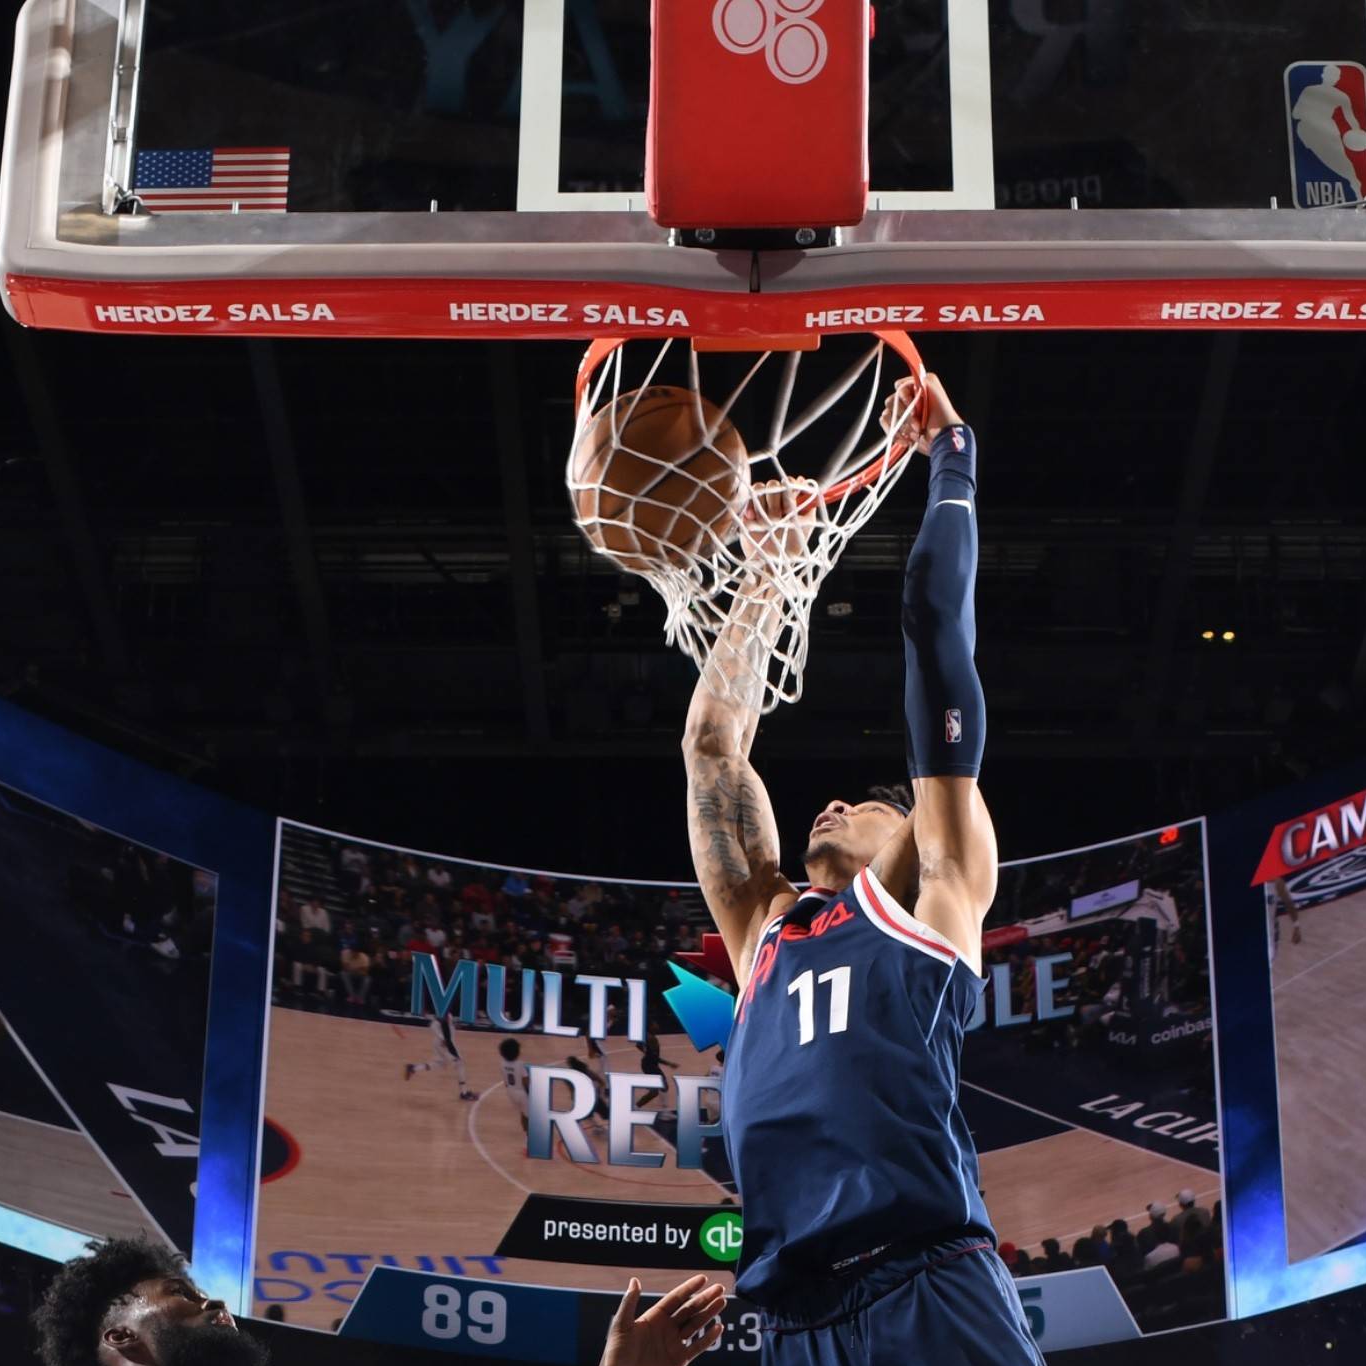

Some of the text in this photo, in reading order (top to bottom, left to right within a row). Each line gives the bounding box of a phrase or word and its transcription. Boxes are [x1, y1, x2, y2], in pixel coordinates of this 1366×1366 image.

[1305, 180, 1347, 206] NBA
[95, 302, 335, 324] HERDEZ SALSA
[449, 302, 690, 327] HERDEZ SALSA
[805, 303, 1045, 328] HERDEZ SALSA
[1160, 301, 1282, 320] HERDEZ
[409, 952, 648, 1044] MULTI
[787, 965, 853, 1047] 11
[1151, 1018, 1214, 1044] coinbas
[525, 1064, 725, 1170] REP
[1080, 1094, 1145, 1121] LA
[544, 1218, 658, 1245] presented
[664, 1223, 692, 1250] by
[421, 1283, 508, 1346] 89
